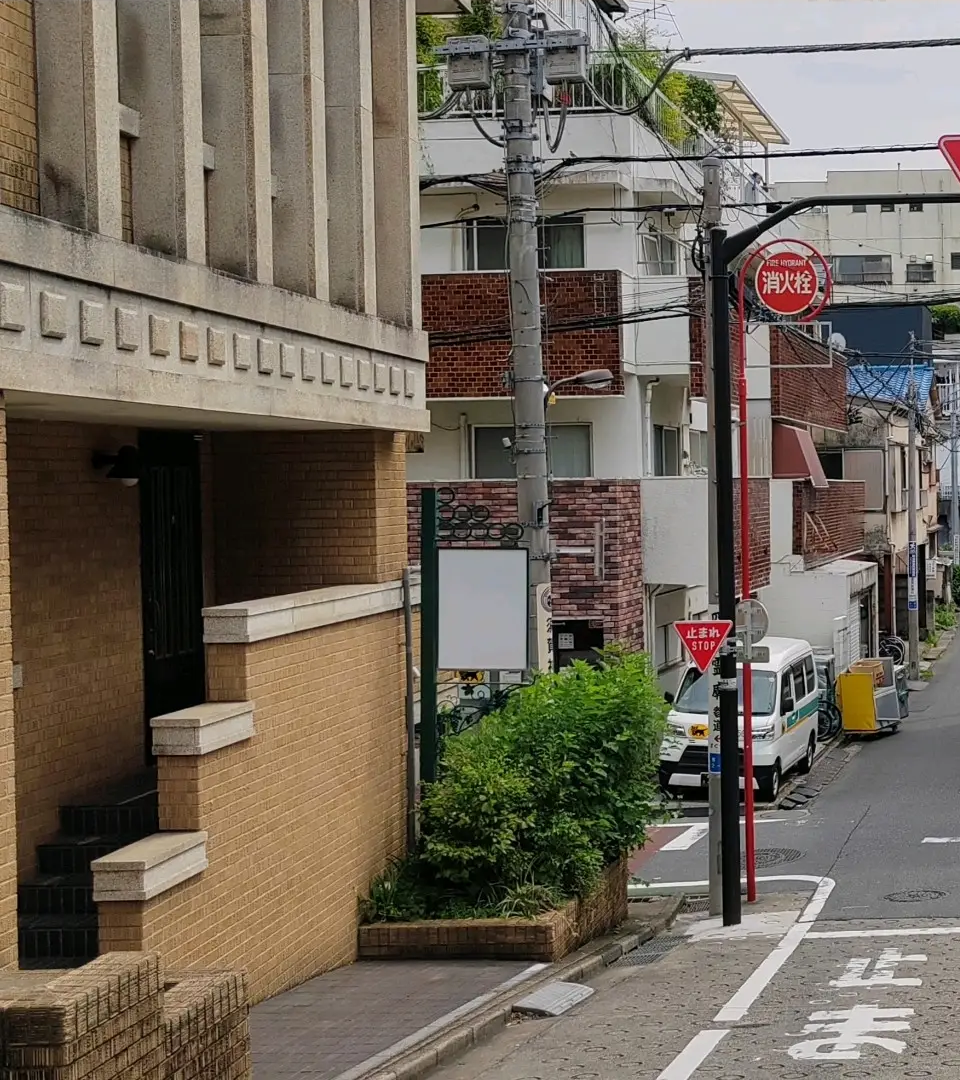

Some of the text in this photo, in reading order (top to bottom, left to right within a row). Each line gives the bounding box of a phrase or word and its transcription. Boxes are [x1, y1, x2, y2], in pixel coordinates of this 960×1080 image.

[766, 259, 806, 267] FIRE HYDRANT
[761, 270, 813, 294] 消火栓
[685, 626, 720, 639] 止まれ
[691, 641, 716, 651] STOP
